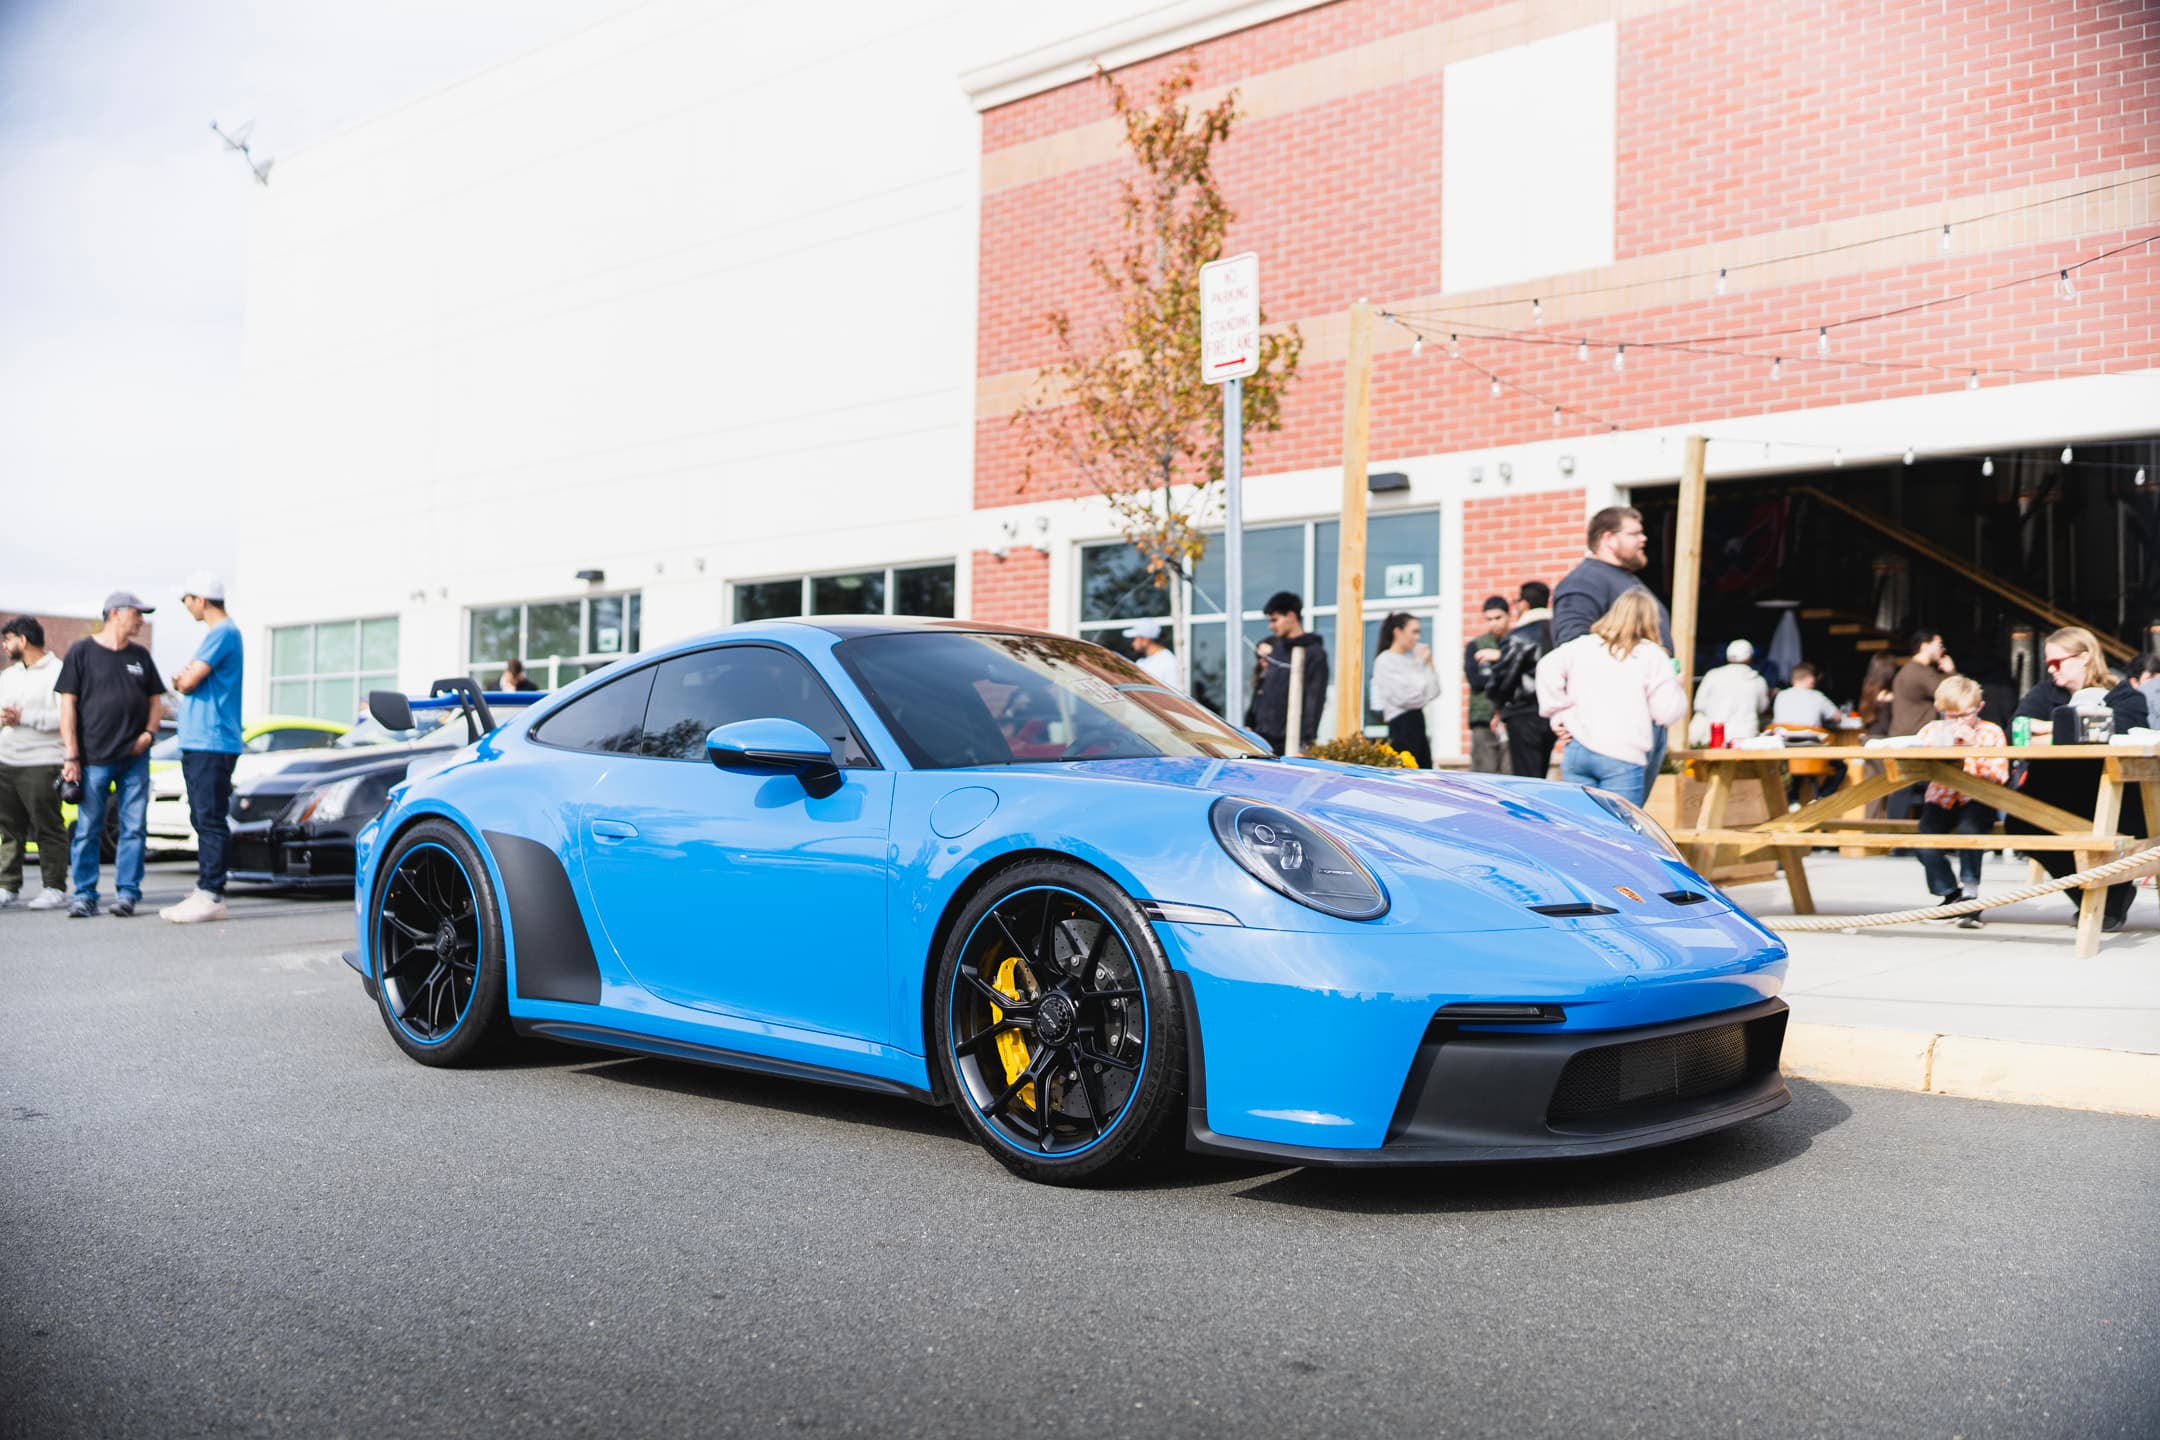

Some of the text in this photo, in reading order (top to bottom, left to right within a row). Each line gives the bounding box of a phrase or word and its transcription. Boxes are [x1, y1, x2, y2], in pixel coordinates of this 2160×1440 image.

[1223, 268, 1237, 282] NO
[1210, 286, 1248, 303] PARKING
[1206, 337, 1227, 358] FIRE
